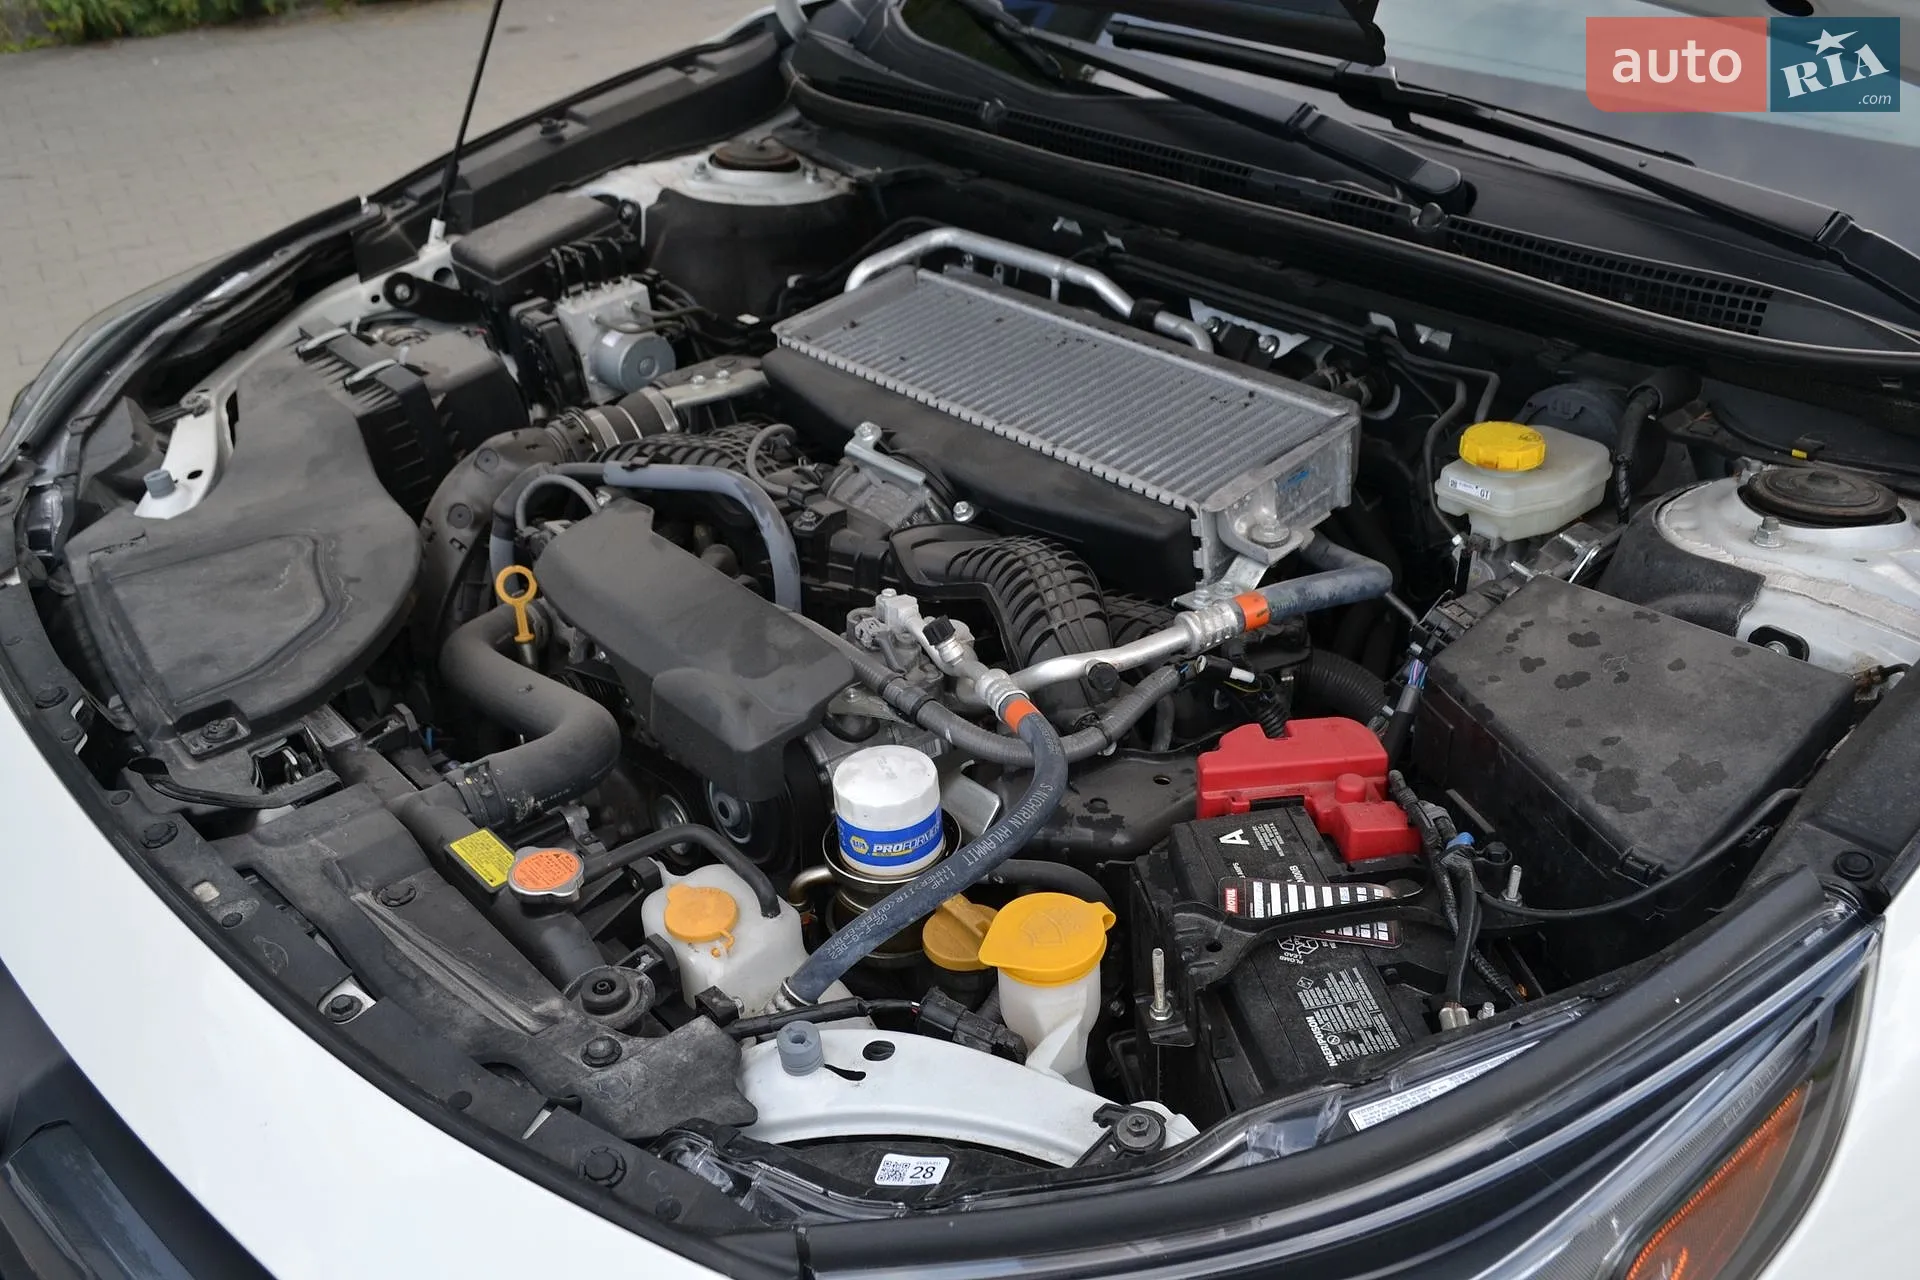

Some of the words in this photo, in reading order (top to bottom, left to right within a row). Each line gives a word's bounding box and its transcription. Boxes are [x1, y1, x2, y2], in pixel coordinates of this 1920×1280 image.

[1219, 828, 1250, 845] A
[962, 828, 1013, 866] HYLAMMIT
[931, 871, 956, 890] 11HP
[1226, 889, 1238, 913] MOTUL
[1284, 951, 1302, 959] LEAD
[1305, 1016, 1338, 1067] NGER/POISON
[910, 1166, 935, 1179] 28
